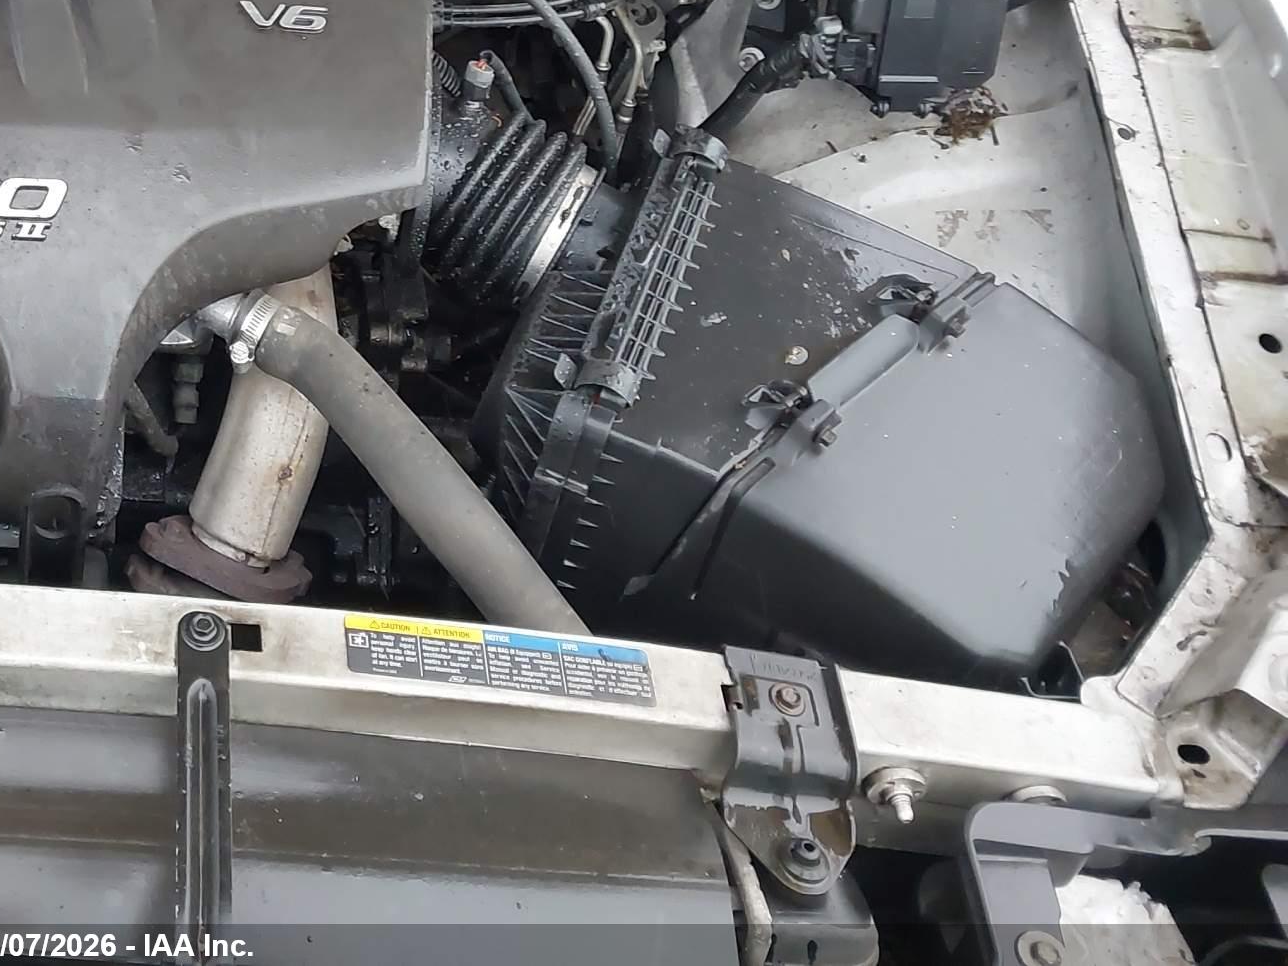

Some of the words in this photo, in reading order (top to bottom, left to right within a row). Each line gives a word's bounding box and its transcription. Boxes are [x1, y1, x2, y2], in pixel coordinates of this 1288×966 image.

[239, 0, 329, 32] V6
[11, 221, 51, 242] II
[381, 623, 410, 631] CAUTION
[433, 629, 469, 638] ATTENTION
[485, 634, 511, 642] NOTICE
